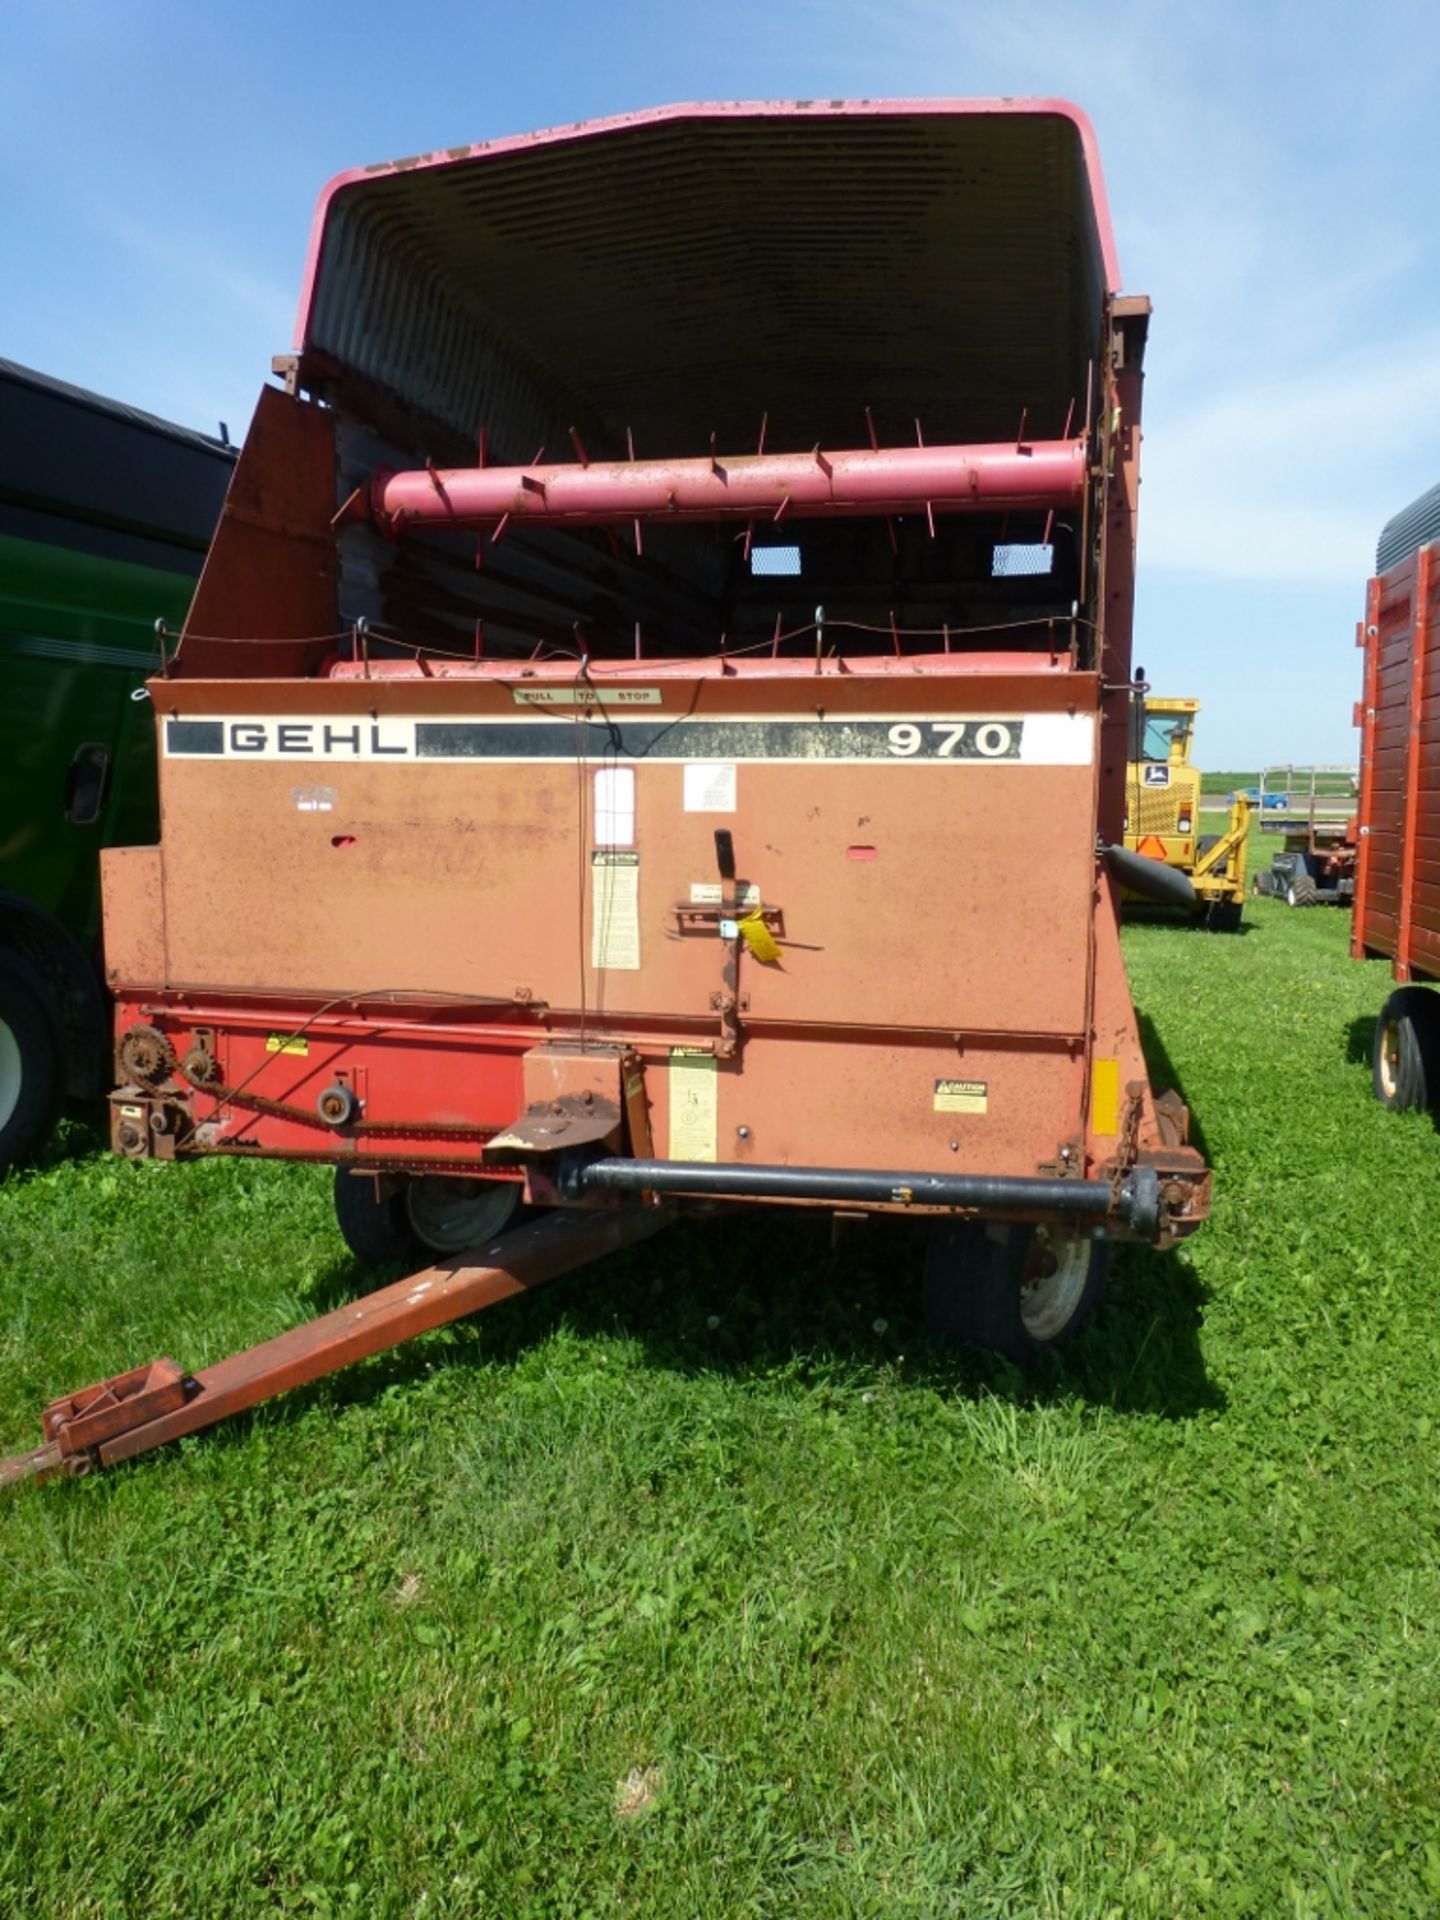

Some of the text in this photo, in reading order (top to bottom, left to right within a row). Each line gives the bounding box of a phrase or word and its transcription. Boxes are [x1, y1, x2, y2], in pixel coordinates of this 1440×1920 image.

[523, 692, 650, 701] PULL TO STOP
[230, 724, 408, 754] GEHL
[886, 723, 1012, 756] 970
